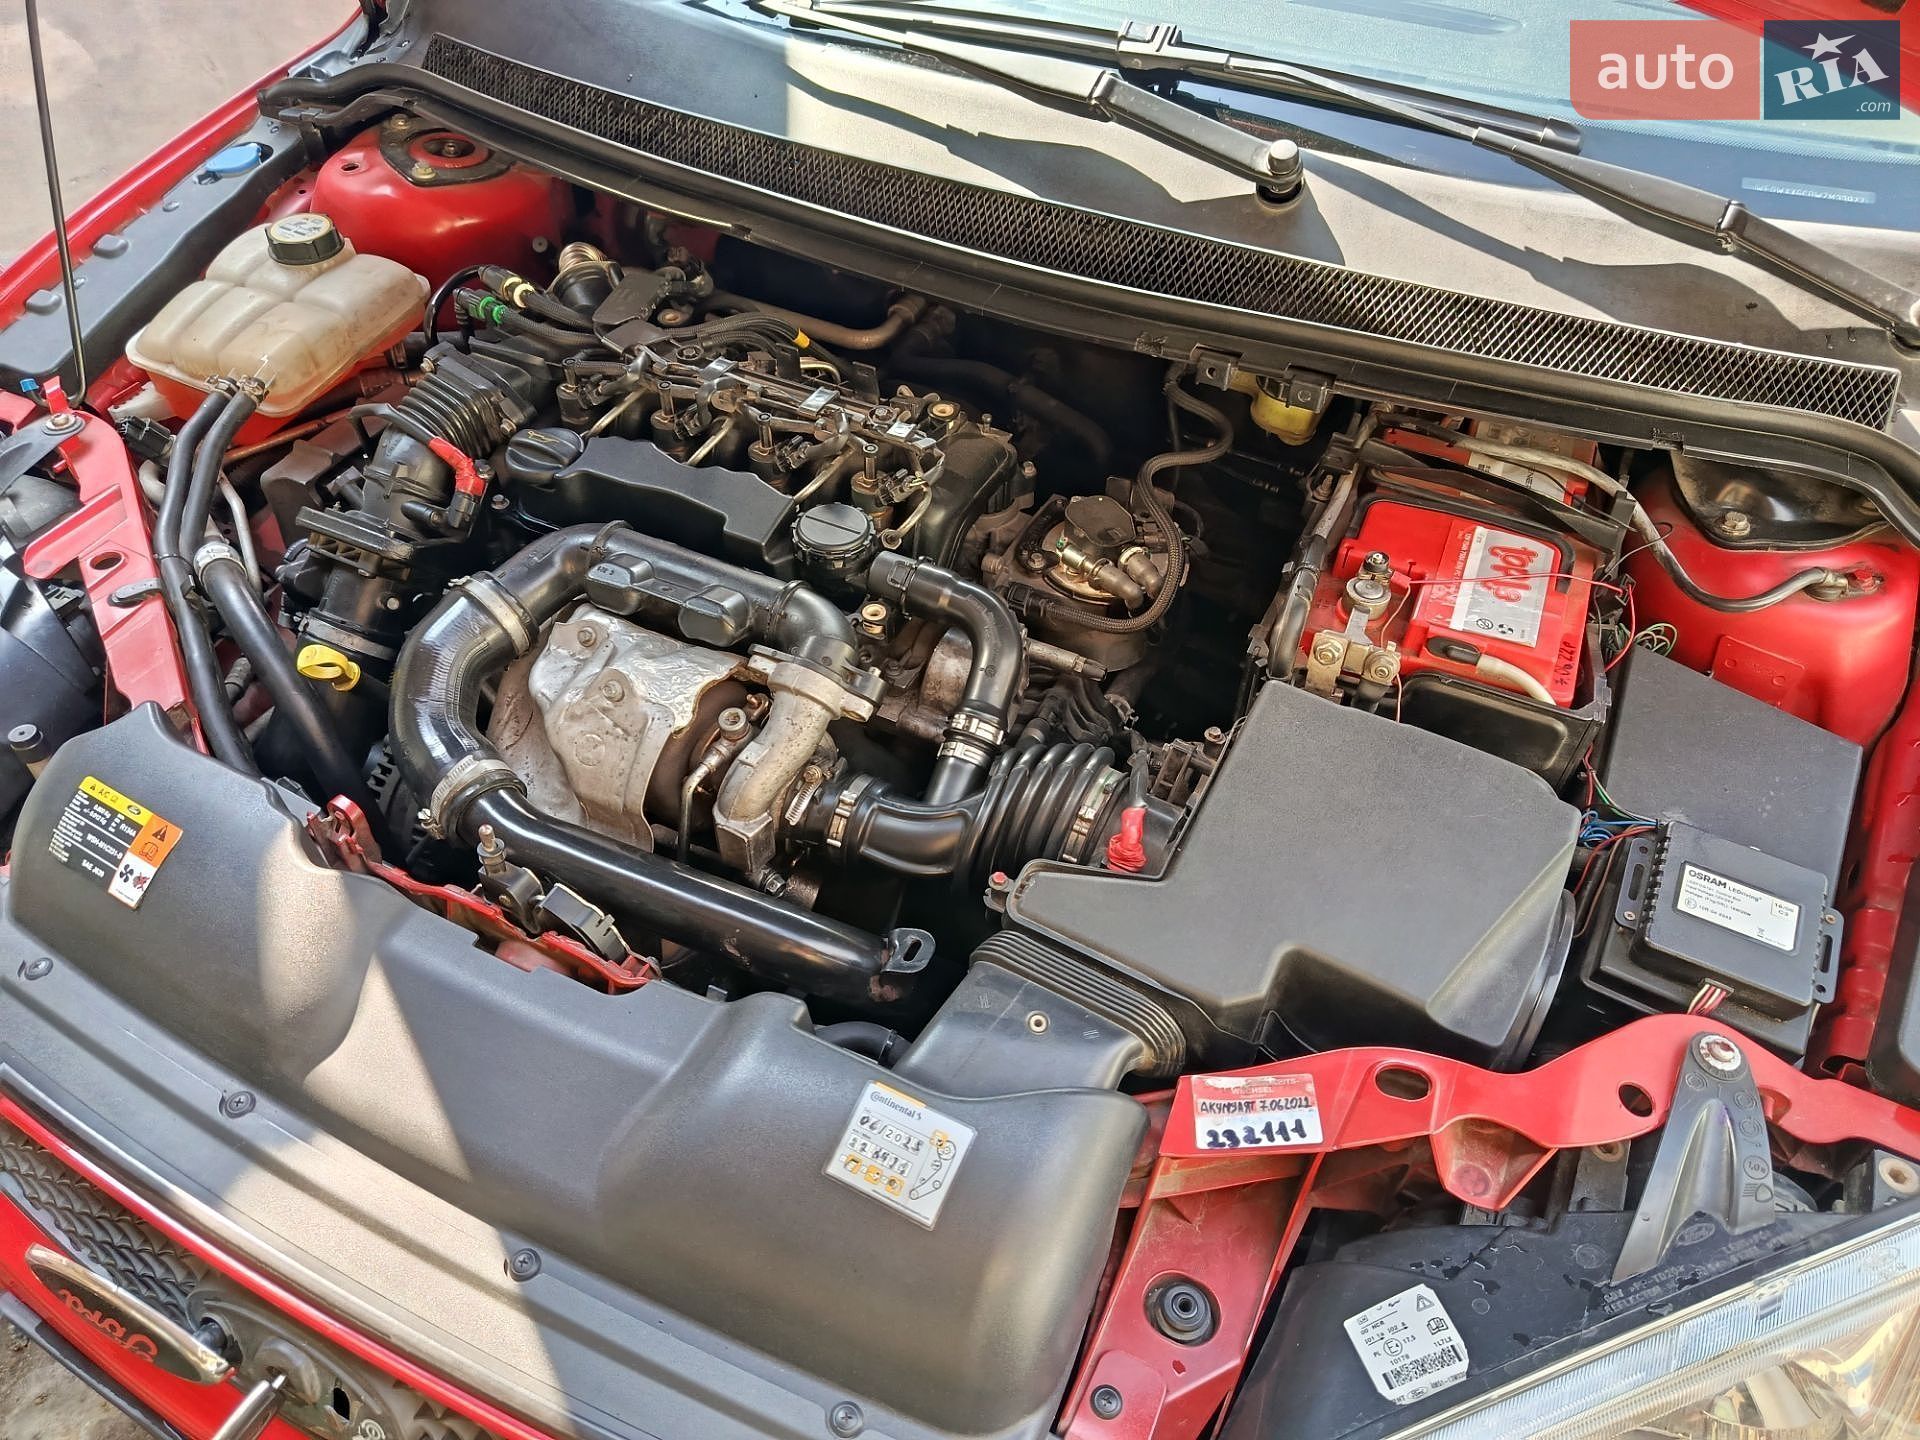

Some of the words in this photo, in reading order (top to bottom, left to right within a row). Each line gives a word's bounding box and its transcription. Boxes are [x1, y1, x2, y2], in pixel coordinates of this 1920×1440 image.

[1688, 869, 1727, 889] OSRAM
[870, 1091, 916, 1118] Continental
[58, 1288, 158, 1363] Ford
